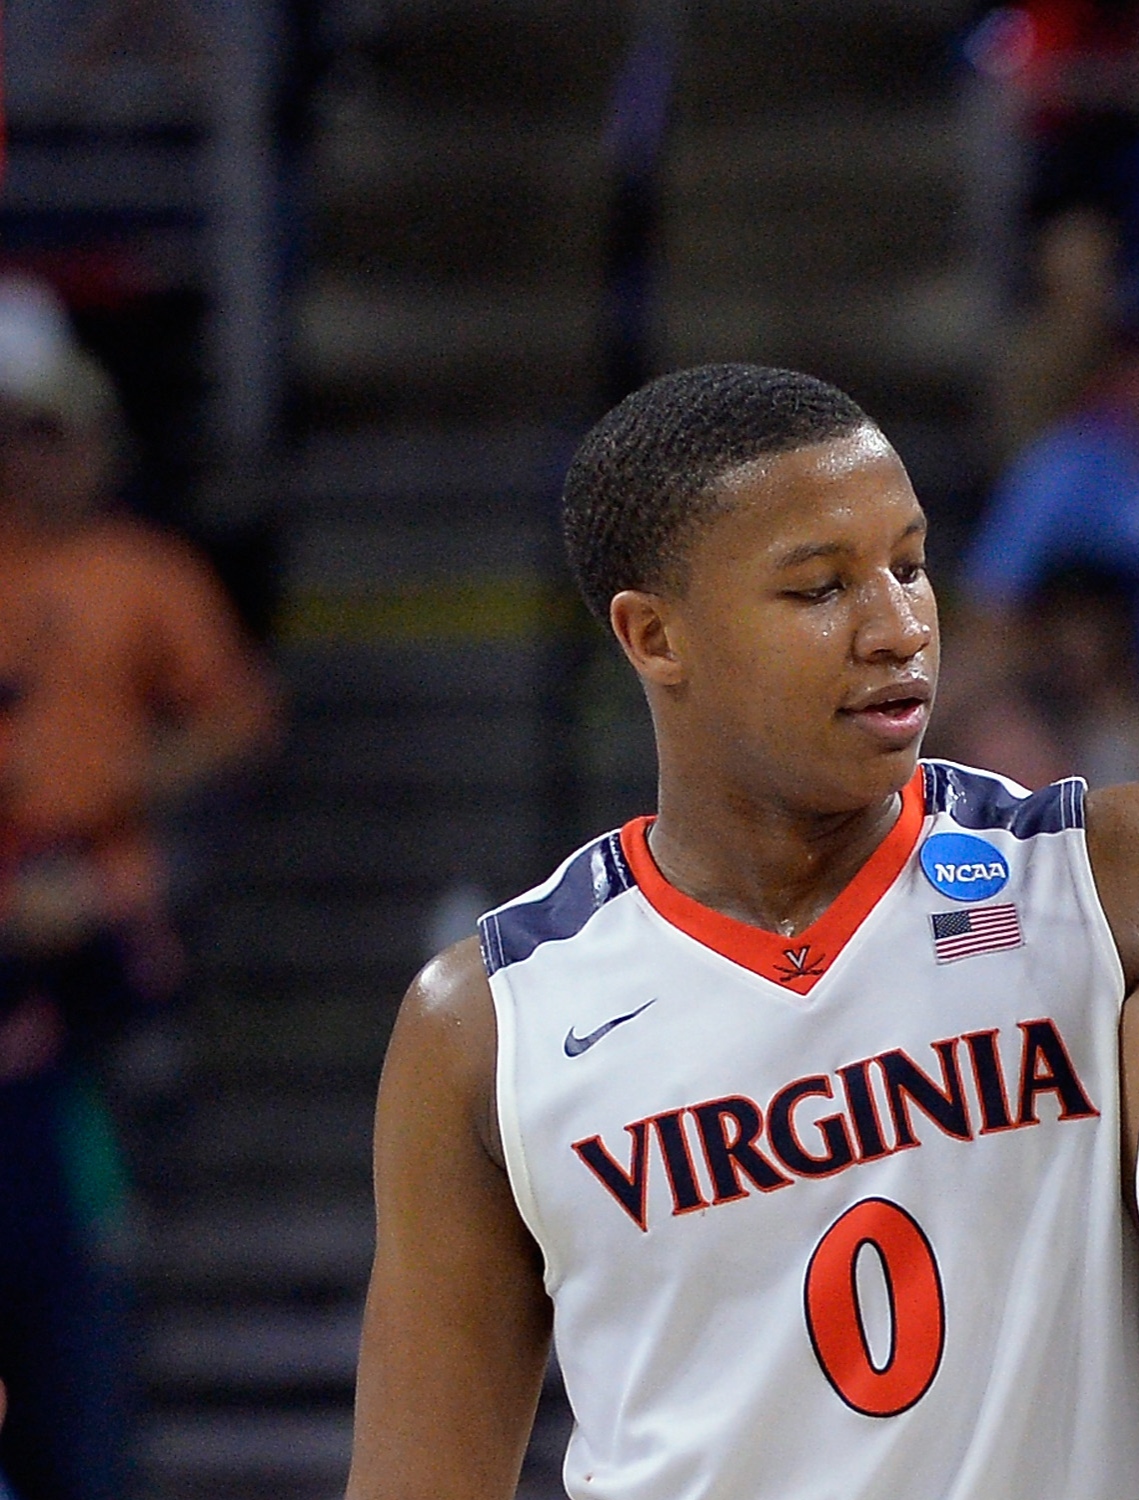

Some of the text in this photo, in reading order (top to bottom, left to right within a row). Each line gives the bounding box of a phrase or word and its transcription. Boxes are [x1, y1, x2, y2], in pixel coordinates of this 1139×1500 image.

[933, 862, 1007, 884] NCAA
[570, 1017, 1101, 1233] VIRGINIA
[803, 1196, 946, 1419] 0
